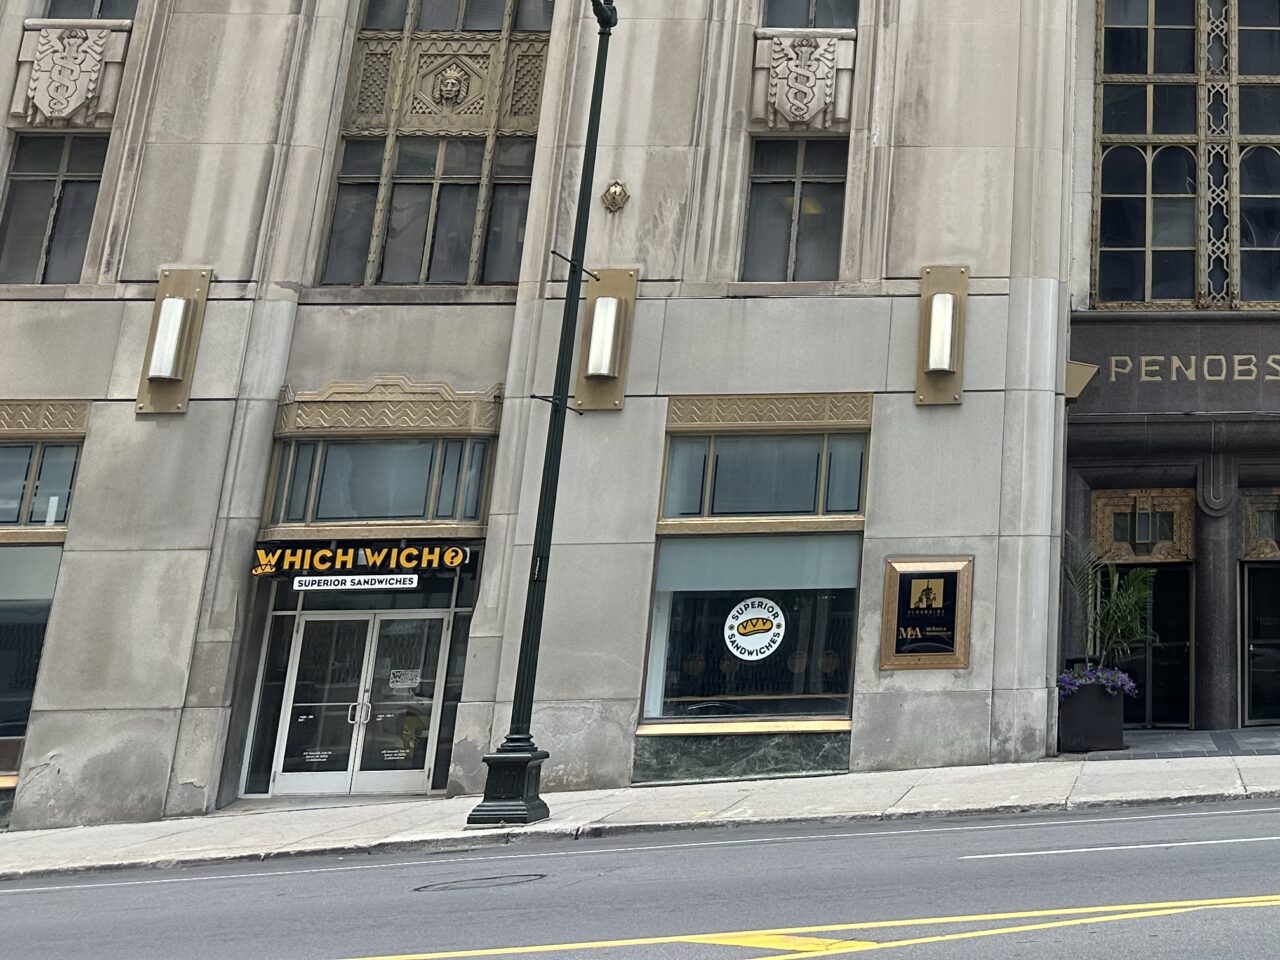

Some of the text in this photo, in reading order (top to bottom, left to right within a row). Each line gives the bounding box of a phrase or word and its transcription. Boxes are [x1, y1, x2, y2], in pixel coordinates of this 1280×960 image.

[252, 548, 354, 575] WHICH
[297, 577, 414, 588] SUPERIOR SANDWICHES
[732, 601, 779, 621] SUPERIOR
[728, 632, 780, 657] SANDWICHES
